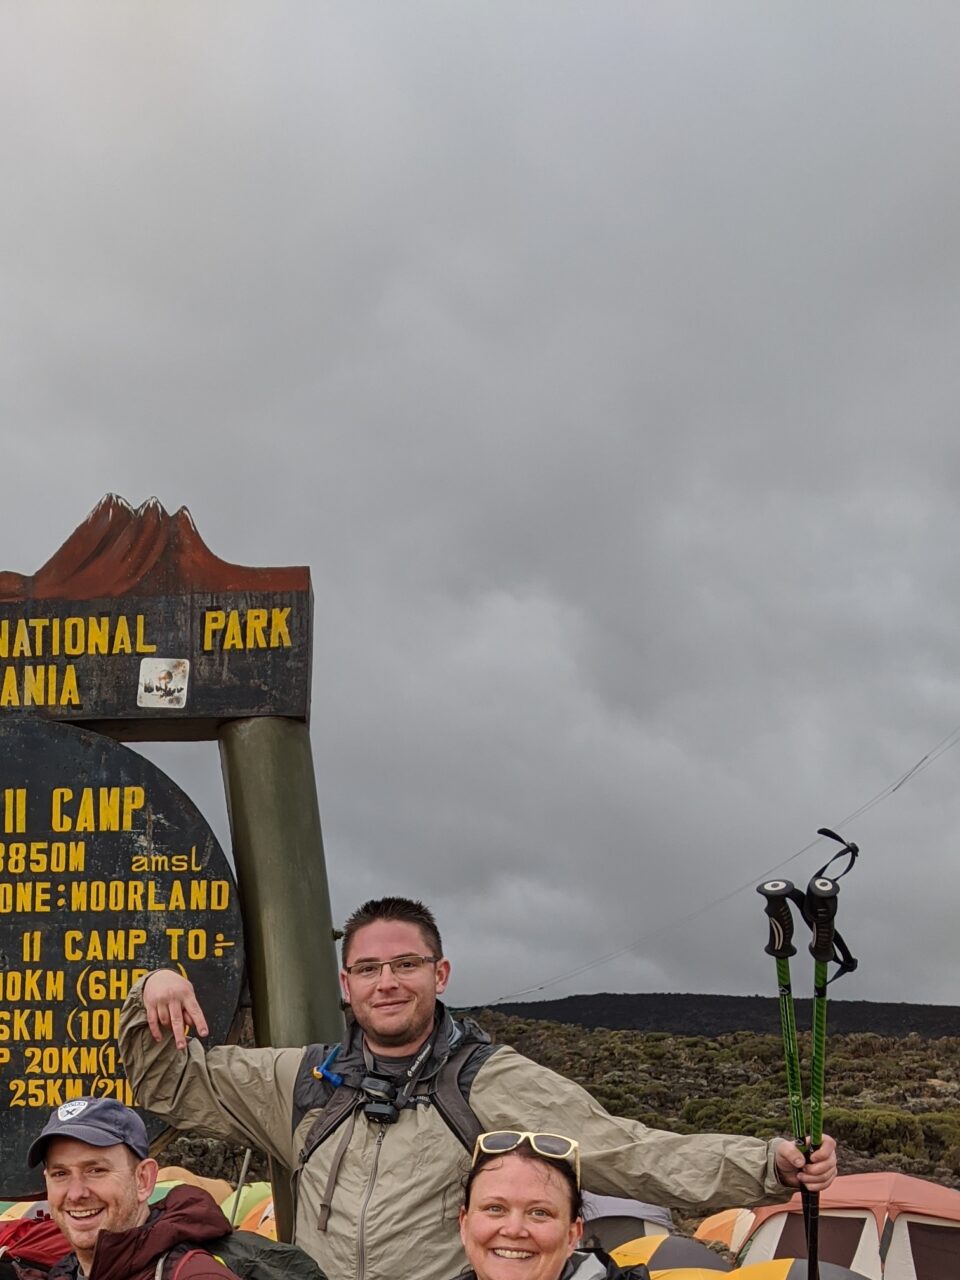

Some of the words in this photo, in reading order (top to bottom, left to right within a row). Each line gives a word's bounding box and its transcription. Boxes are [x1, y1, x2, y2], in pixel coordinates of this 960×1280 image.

[203, 607, 292, 652] PARK
[51, 786, 146, 833] CAMP
[131, 845, 202, 872] amsl
[64, 928, 147, 961] CAMP
[9, 1078, 83, 1107] 25KM
